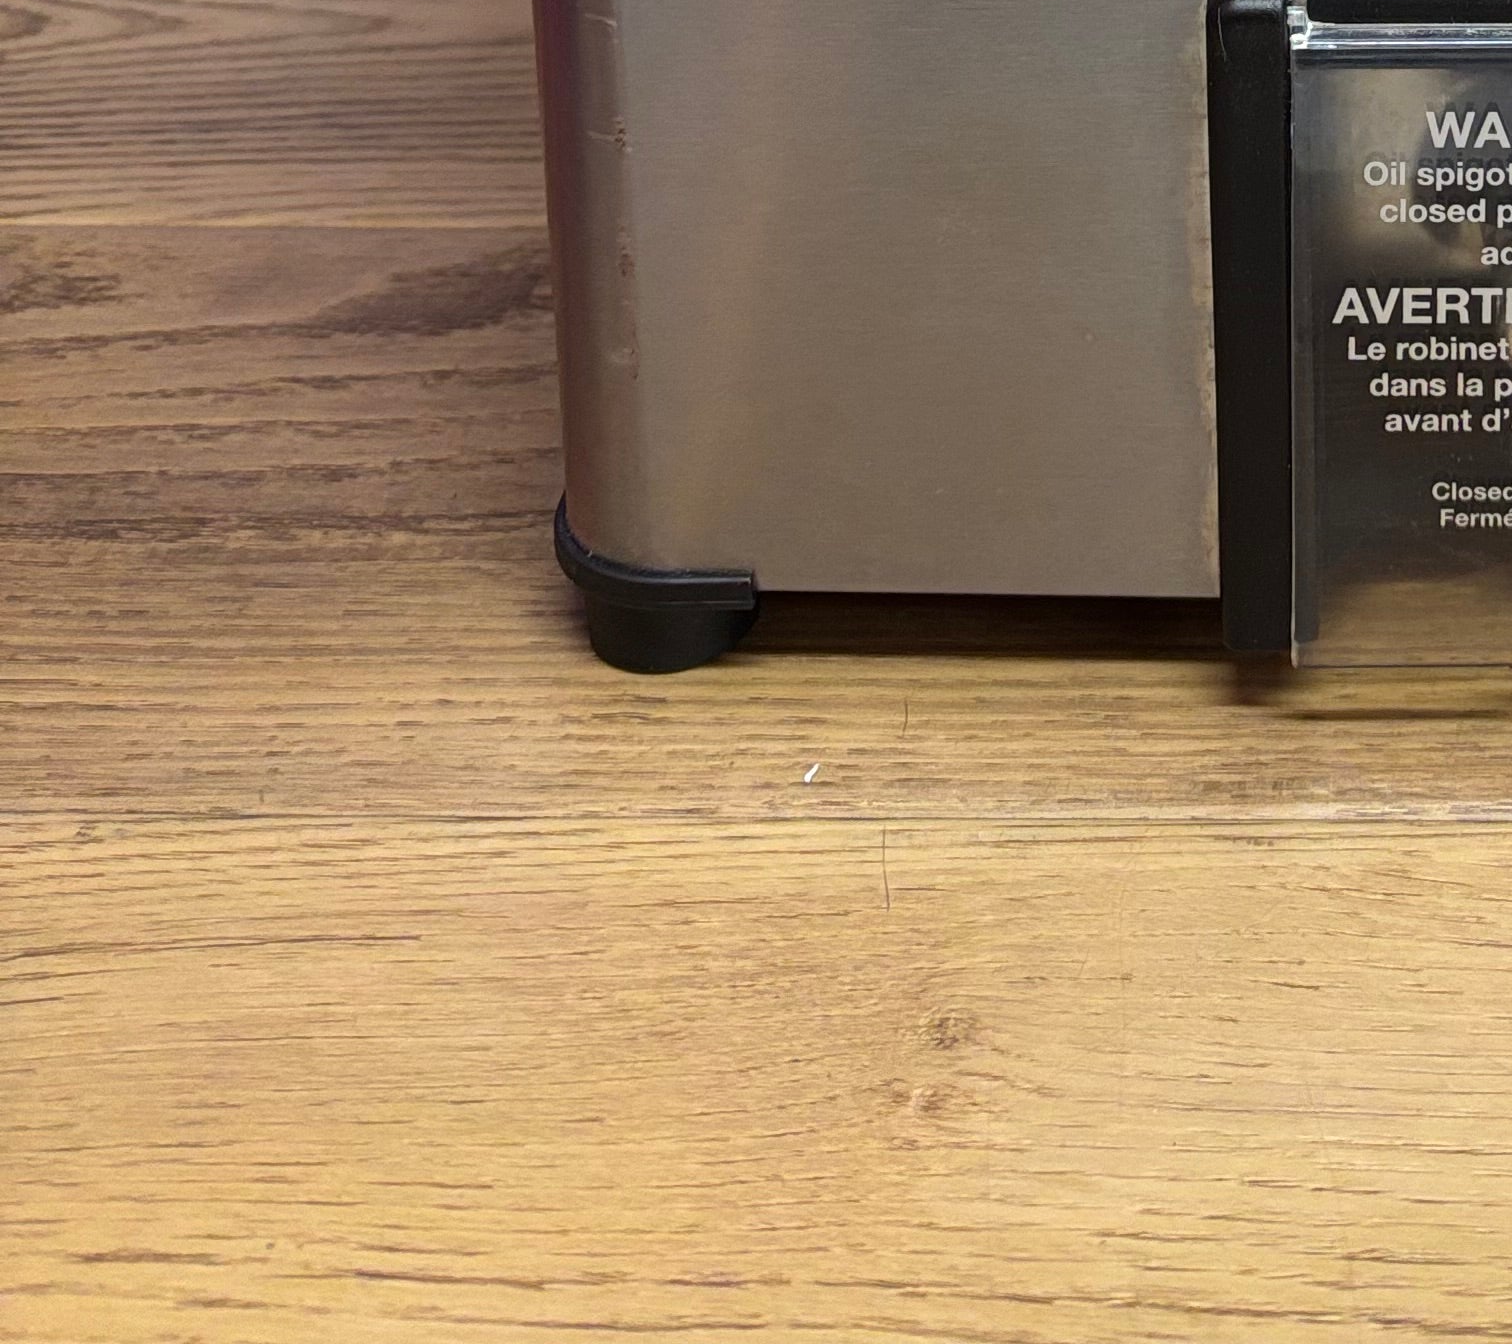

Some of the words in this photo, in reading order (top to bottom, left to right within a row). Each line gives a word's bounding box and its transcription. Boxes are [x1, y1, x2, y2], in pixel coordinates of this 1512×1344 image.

[1363, 160, 1406, 187] Oil
[1379, 199, 1487, 224] closed
[1348, 337, 1387, 361] Le
[1396, 336, 1510, 361] robinet
[1369, 372, 1447, 397] dans
[1457, 372, 1484, 397] la
[1384, 411, 1472, 432] avant
